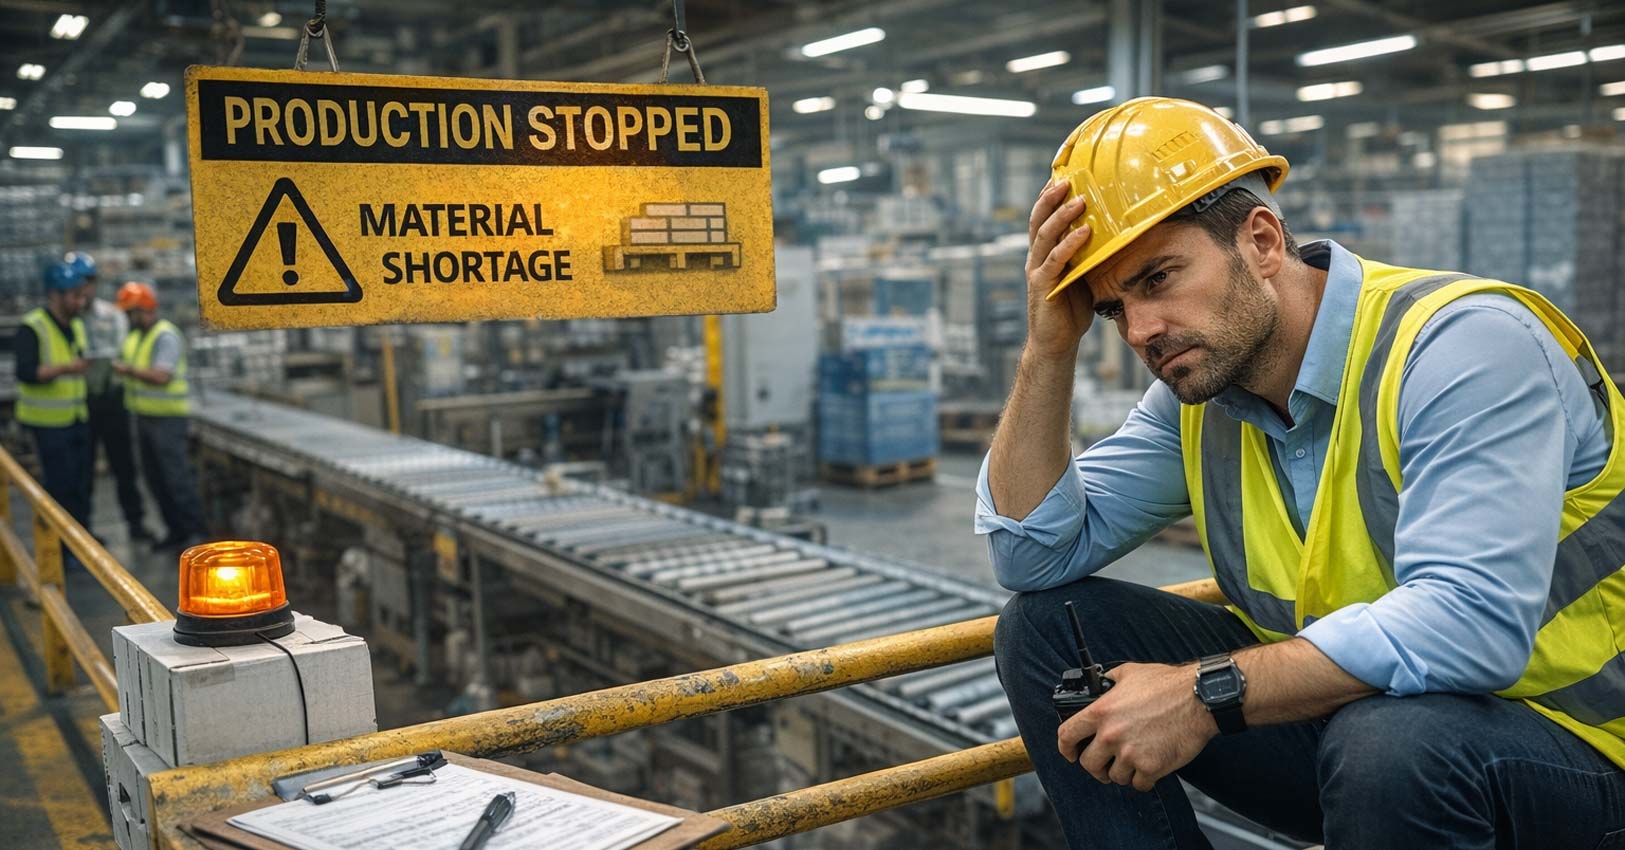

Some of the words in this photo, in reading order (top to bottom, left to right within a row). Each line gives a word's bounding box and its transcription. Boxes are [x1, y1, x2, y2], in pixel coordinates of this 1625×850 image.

[224, 96, 514, 149] PRODUCTION
[527, 105, 732, 152] STOPPED
[359, 203, 554, 237] MATERIAL
[382, 250, 573, 285] SHORTAGE
